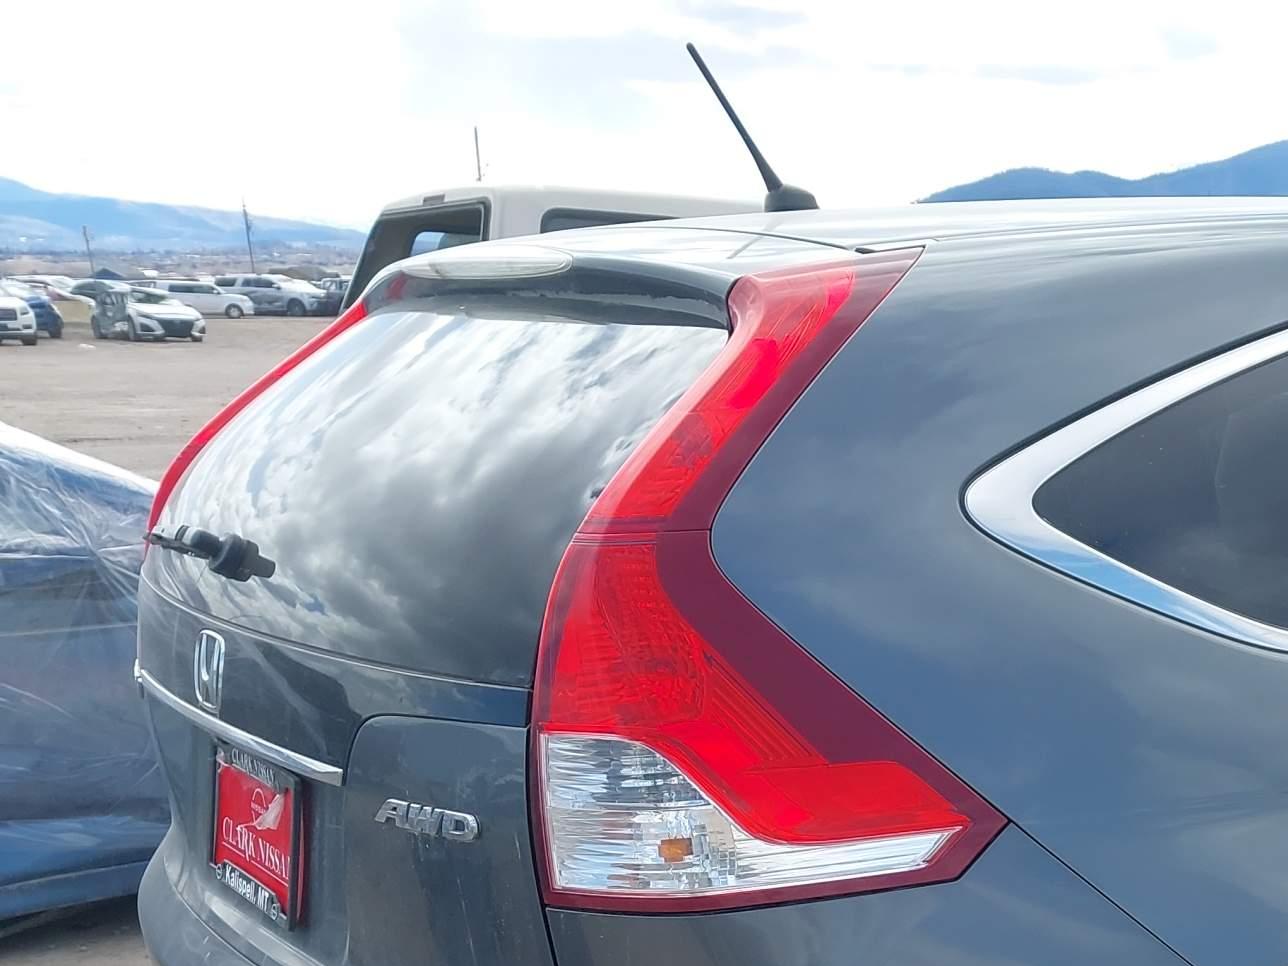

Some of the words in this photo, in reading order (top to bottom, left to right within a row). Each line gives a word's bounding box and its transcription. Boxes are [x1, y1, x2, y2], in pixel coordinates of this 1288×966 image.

[231, 748, 253, 774] CLARK
[253, 759, 275, 785] NISSAN
[222, 816, 257, 862] CLARK
[374, 799, 479, 843] AWD
[257, 887, 270, 912] MT
